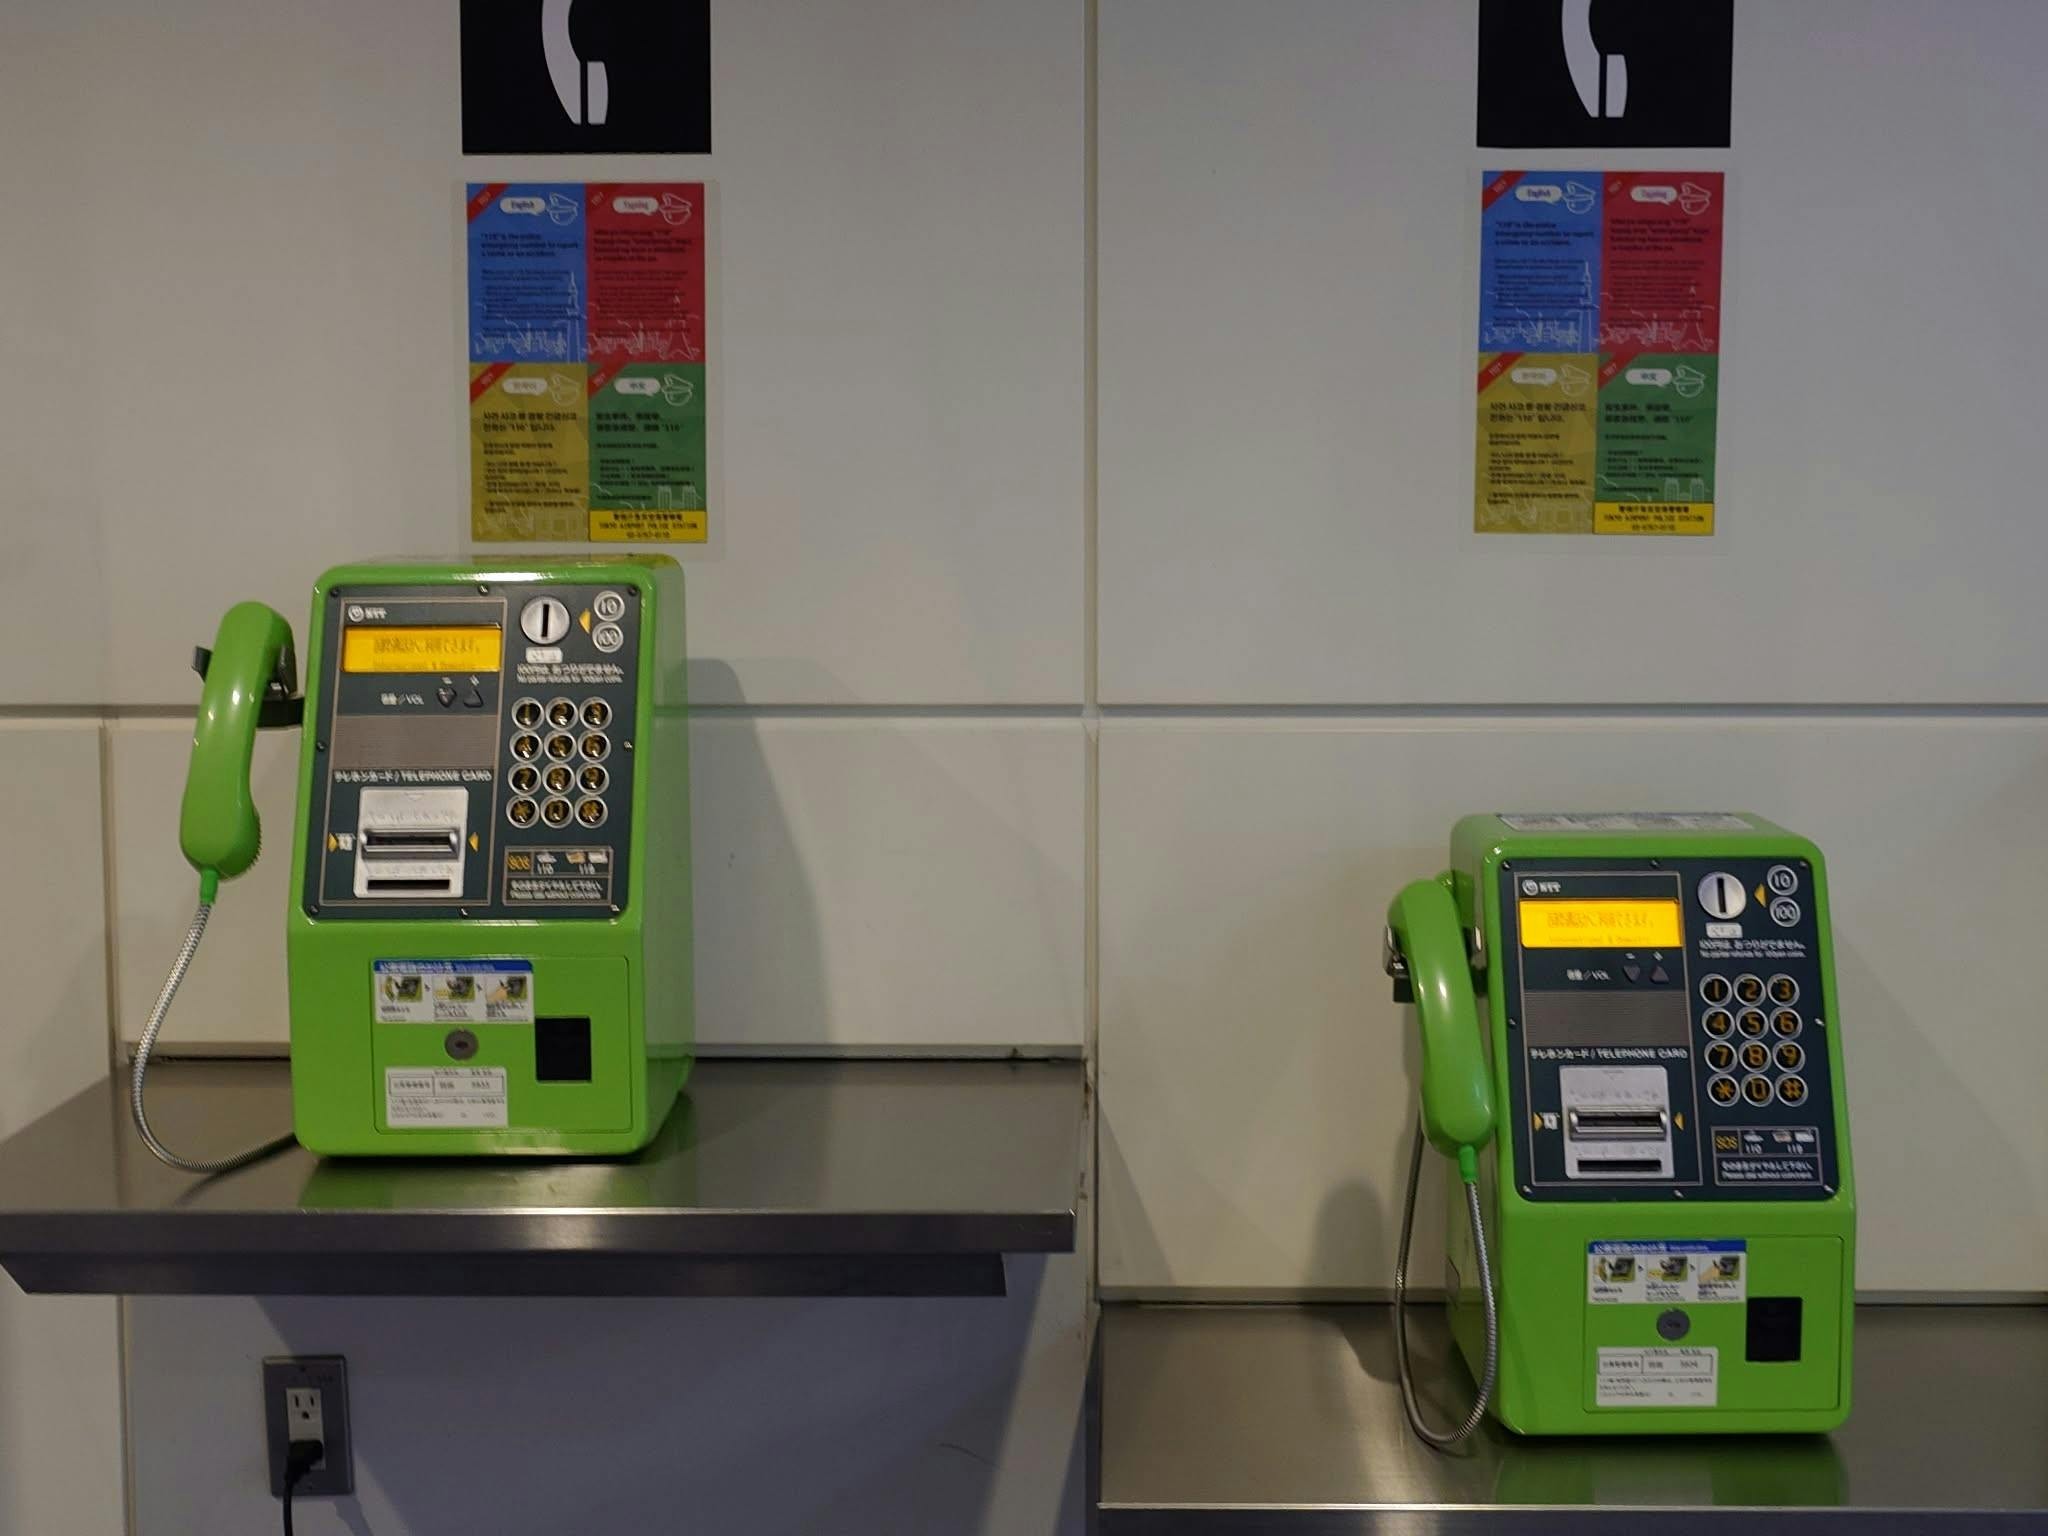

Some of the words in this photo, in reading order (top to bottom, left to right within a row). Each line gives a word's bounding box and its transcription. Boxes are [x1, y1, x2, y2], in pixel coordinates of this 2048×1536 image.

[364, 607, 387, 619] NTT
[401, 770, 461, 782] TELEPHONE
[462, 770, 493, 782] CARD
[1539, 882, 1562, 893] NTT
[1745, 980, 1757, 999] 2
[1779, 980, 1791, 999] 3
[1715, 1014, 1729, 1033] 4
[1748, 1014, 1760, 1033] 5
[1781, 1014, 1795, 1033] 6
[1597, 1048, 1657, 1059] TELEPHONE
[1658, 1048, 1689, 1059] CARD
[1718, 1047, 1729, 1066] 7
[1750, 1047, 1764, 1066] 8
[1783, 1047, 1797, 1066] 9
[1753, 1080, 1767, 1100] 0
[1715, 1135, 1738, 1150] SOS
[1745, 1143, 1762, 1154] 110
